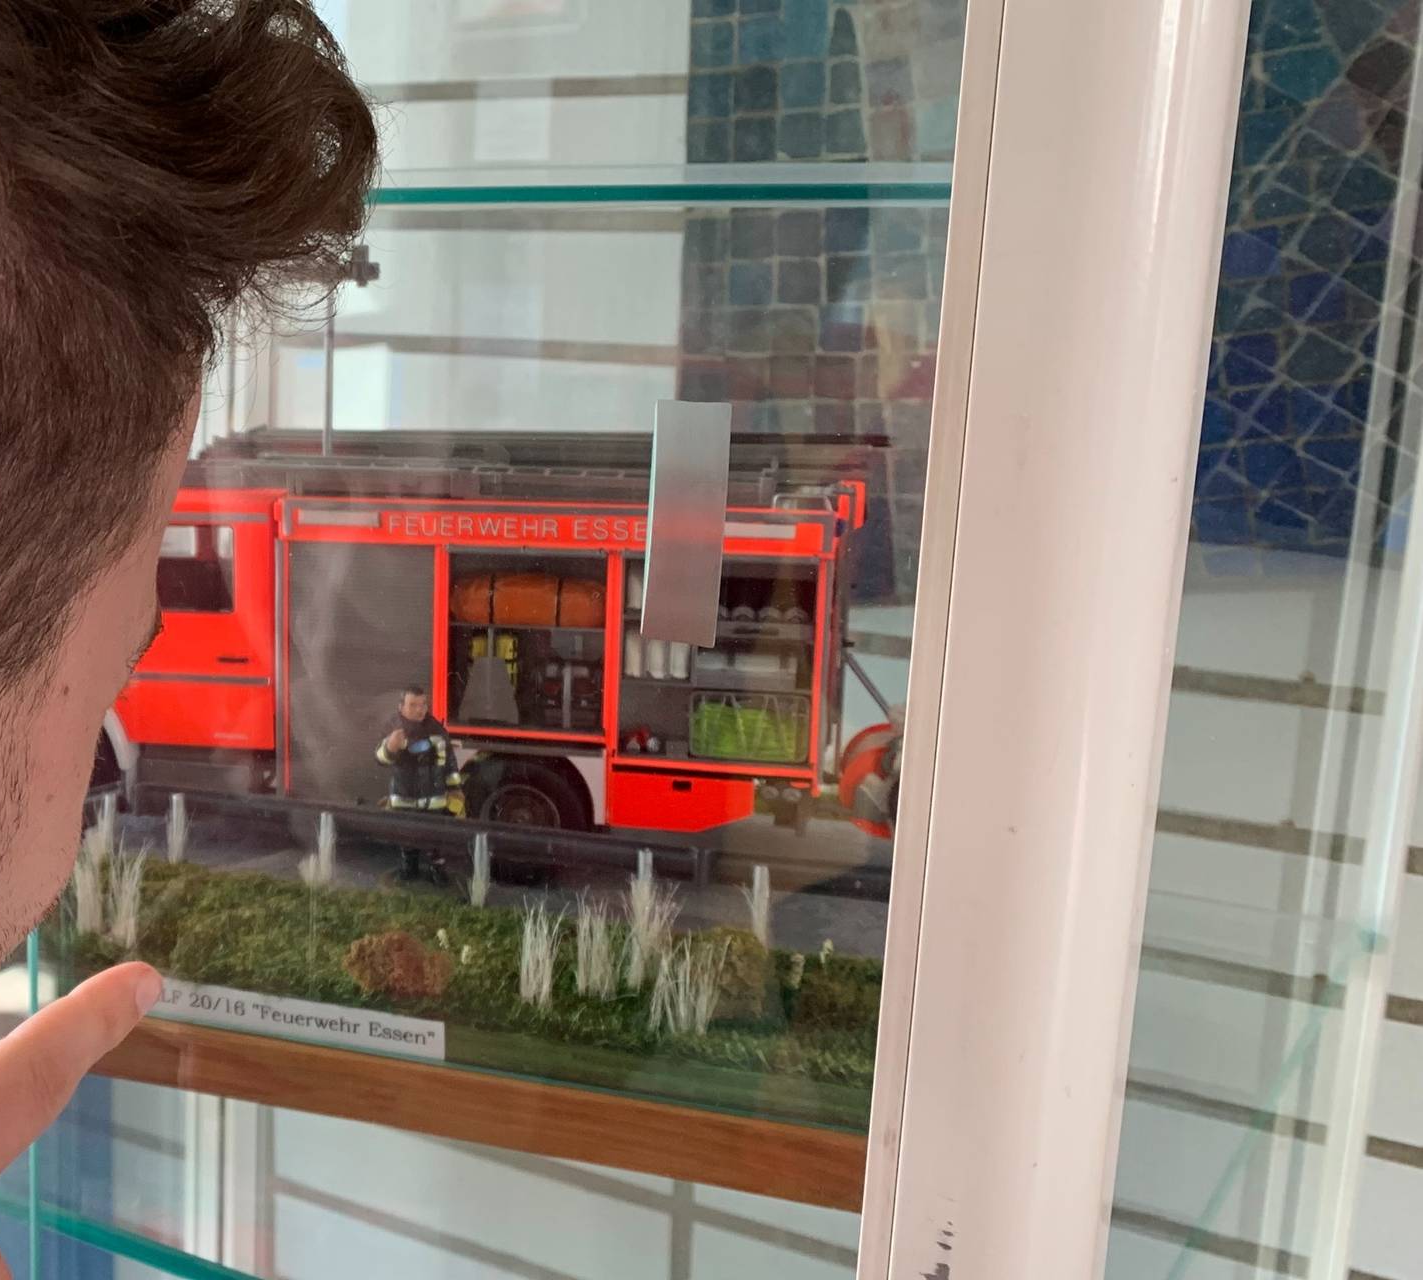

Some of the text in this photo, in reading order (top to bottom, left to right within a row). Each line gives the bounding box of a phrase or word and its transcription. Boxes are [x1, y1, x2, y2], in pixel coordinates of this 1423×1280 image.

[388, 513, 648, 542] FEUERWEHR ESSE
[159, 987, 183, 1005] LF
[252, 1003, 361, 1034] "Feuerwehr
[368, 1020, 436, 1046] Essen"
